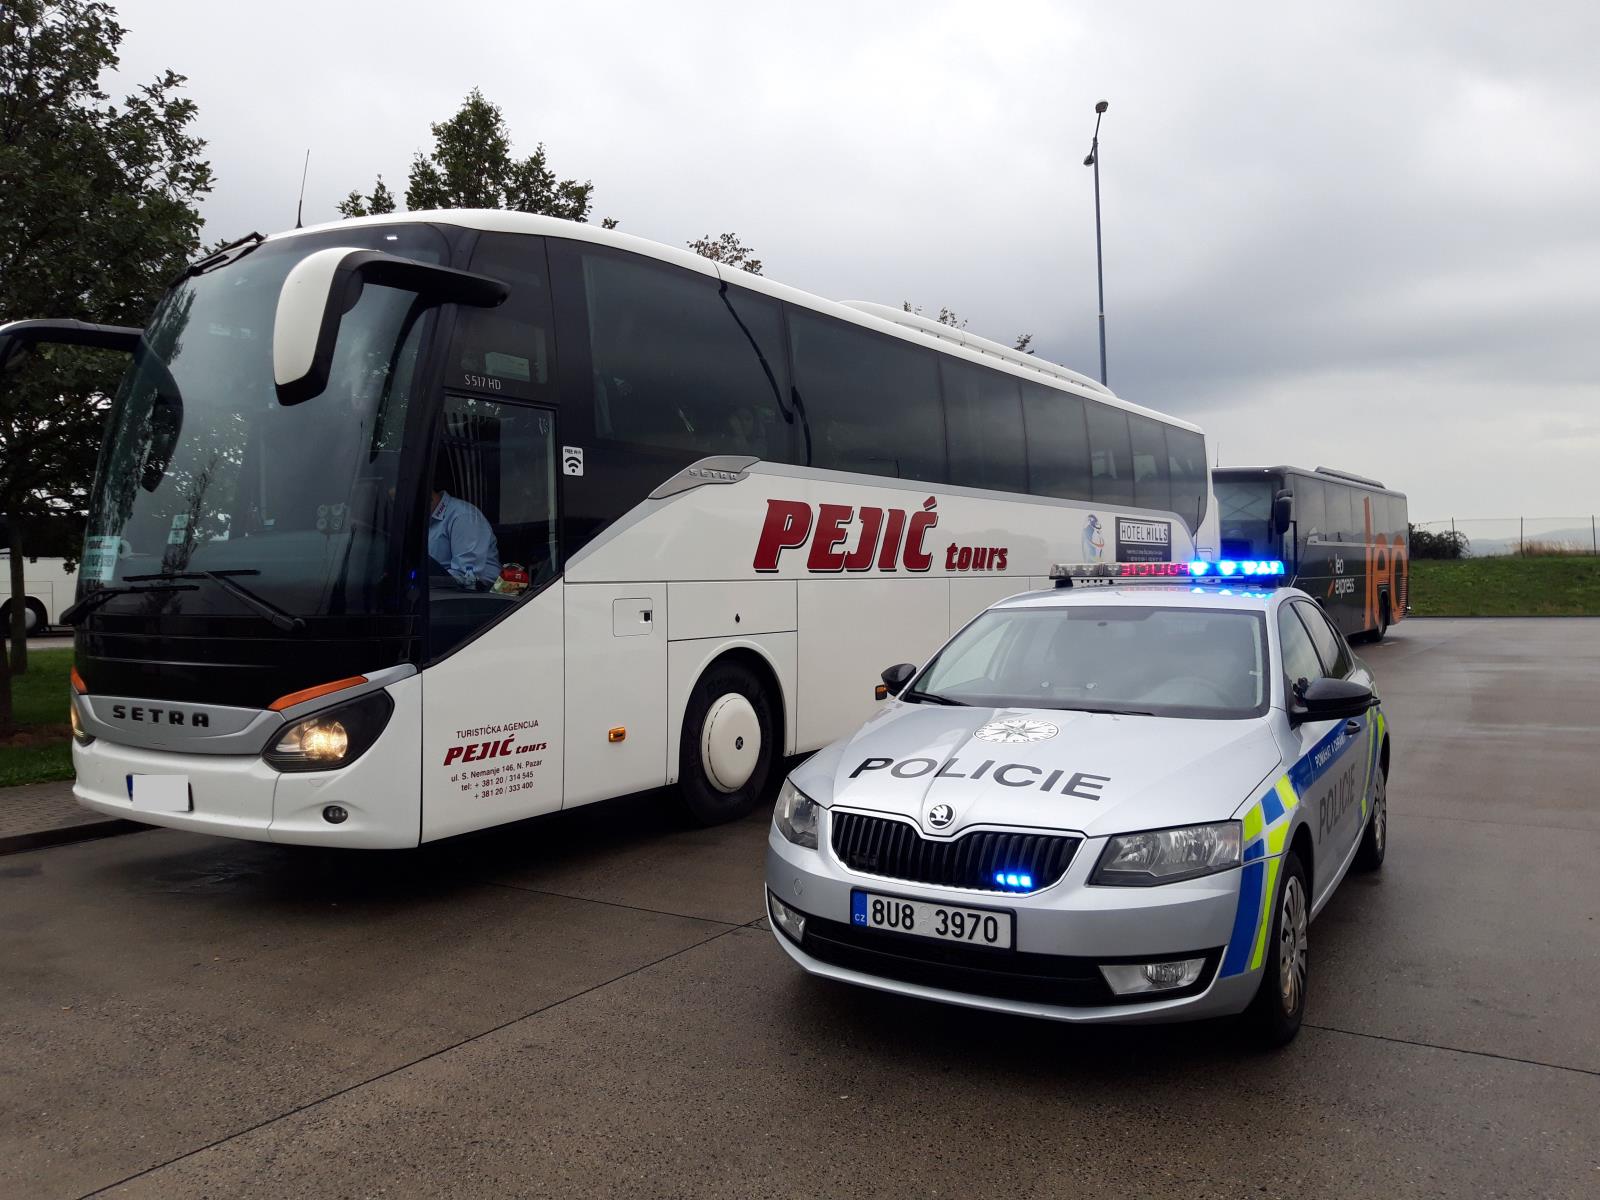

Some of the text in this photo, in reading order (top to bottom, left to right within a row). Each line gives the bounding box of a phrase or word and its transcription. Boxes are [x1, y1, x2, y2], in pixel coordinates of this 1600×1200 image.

[488, 378, 501, 390] HD
[688, 469, 738, 481] SETRA
[753, 495, 1008, 573] PEJIĆ tours
[1121, 524, 1168, 542] HOTEL HILLS
[1335, 553, 1344, 575] leo
[1335, 577, 1355, 599] express
[113, 704, 209, 728] SETRA
[503, 719, 539, 732] AGENCIJA
[443, 733, 547, 766] PEJIĆ tours
[451, 759, 543, 783] ul. S. Nemanje 146, N. Pazar
[461, 782, 472, 792] tel:
[481, 779, 494, 788] 381
[495, 776, 504, 785] 20
[509, 773, 521, 782] 314
[522, 770, 534, 780] 545
[848, 757, 1111, 802] POLICIE
[481, 789, 494, 799] 381
[495, 787, 504, 796] 20
[509, 783, 521, 793] 333
[522, 781, 534, 790] 400
[1318, 763, 1356, 845] POLICIE
[854, 913, 866, 922] CZ
[872, 899, 998, 943] 8U8 3970
